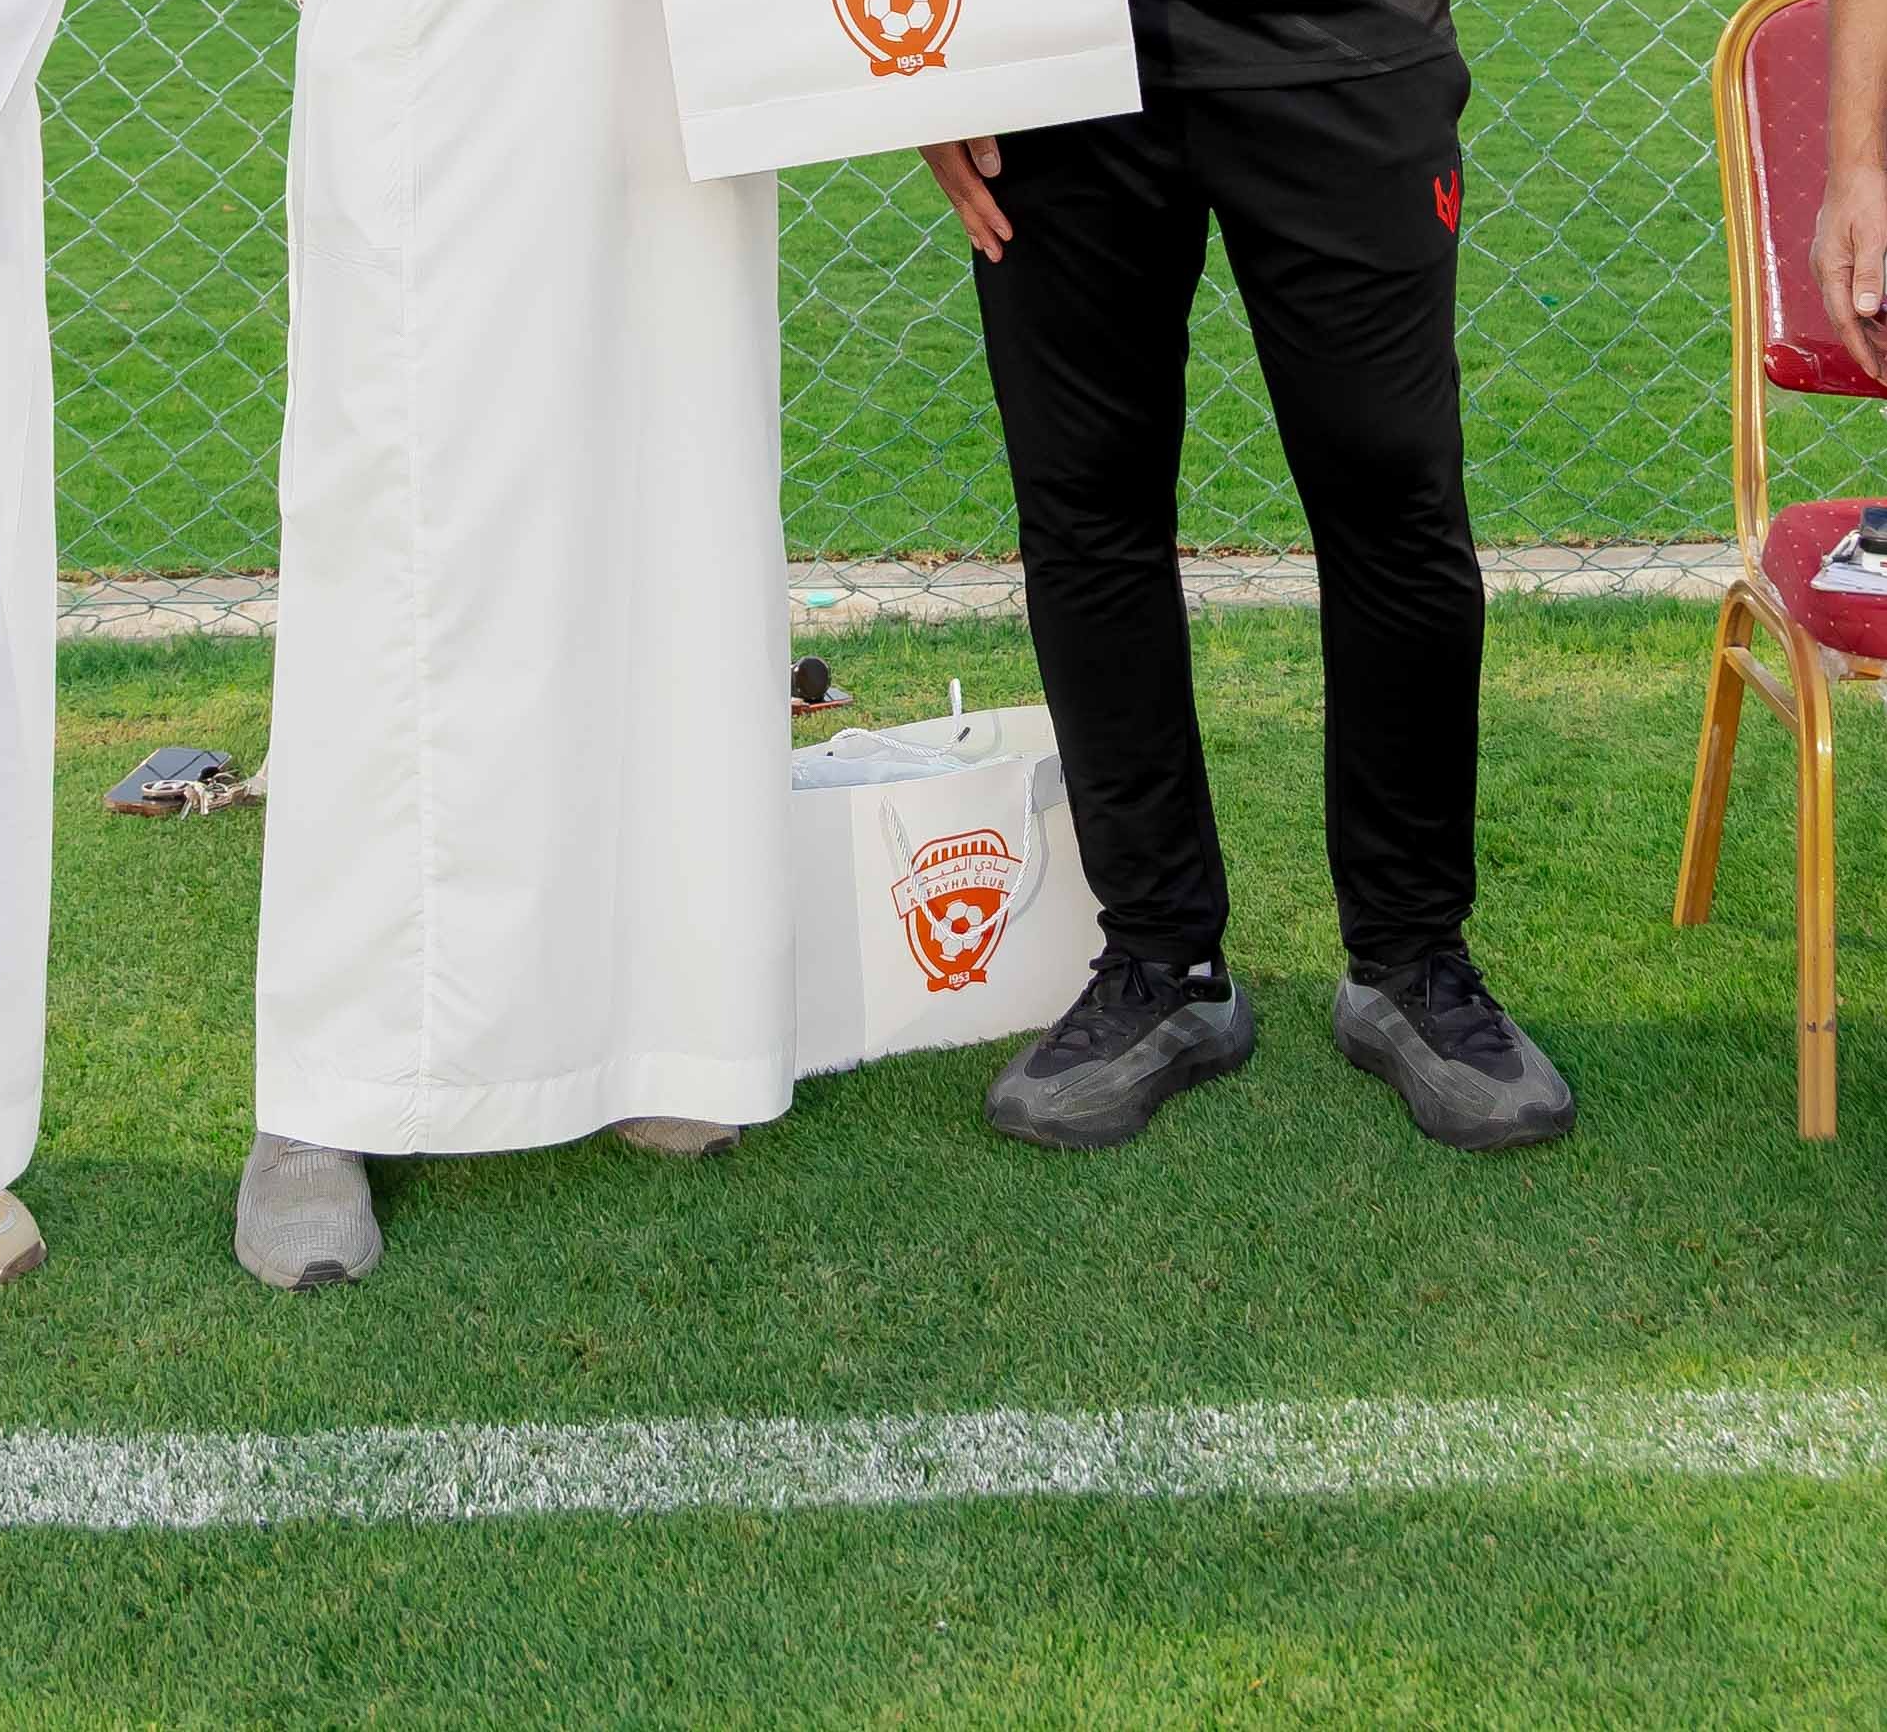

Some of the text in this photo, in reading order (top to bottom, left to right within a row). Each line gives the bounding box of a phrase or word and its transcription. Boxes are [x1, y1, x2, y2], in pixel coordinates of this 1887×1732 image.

[896, 54, 924, 69] 1953
[975, 858, 1010, 875] نادي
[910, 875, 1005, 905] AFAYHA CLUB
[948, 971, 970, 985] 1953
